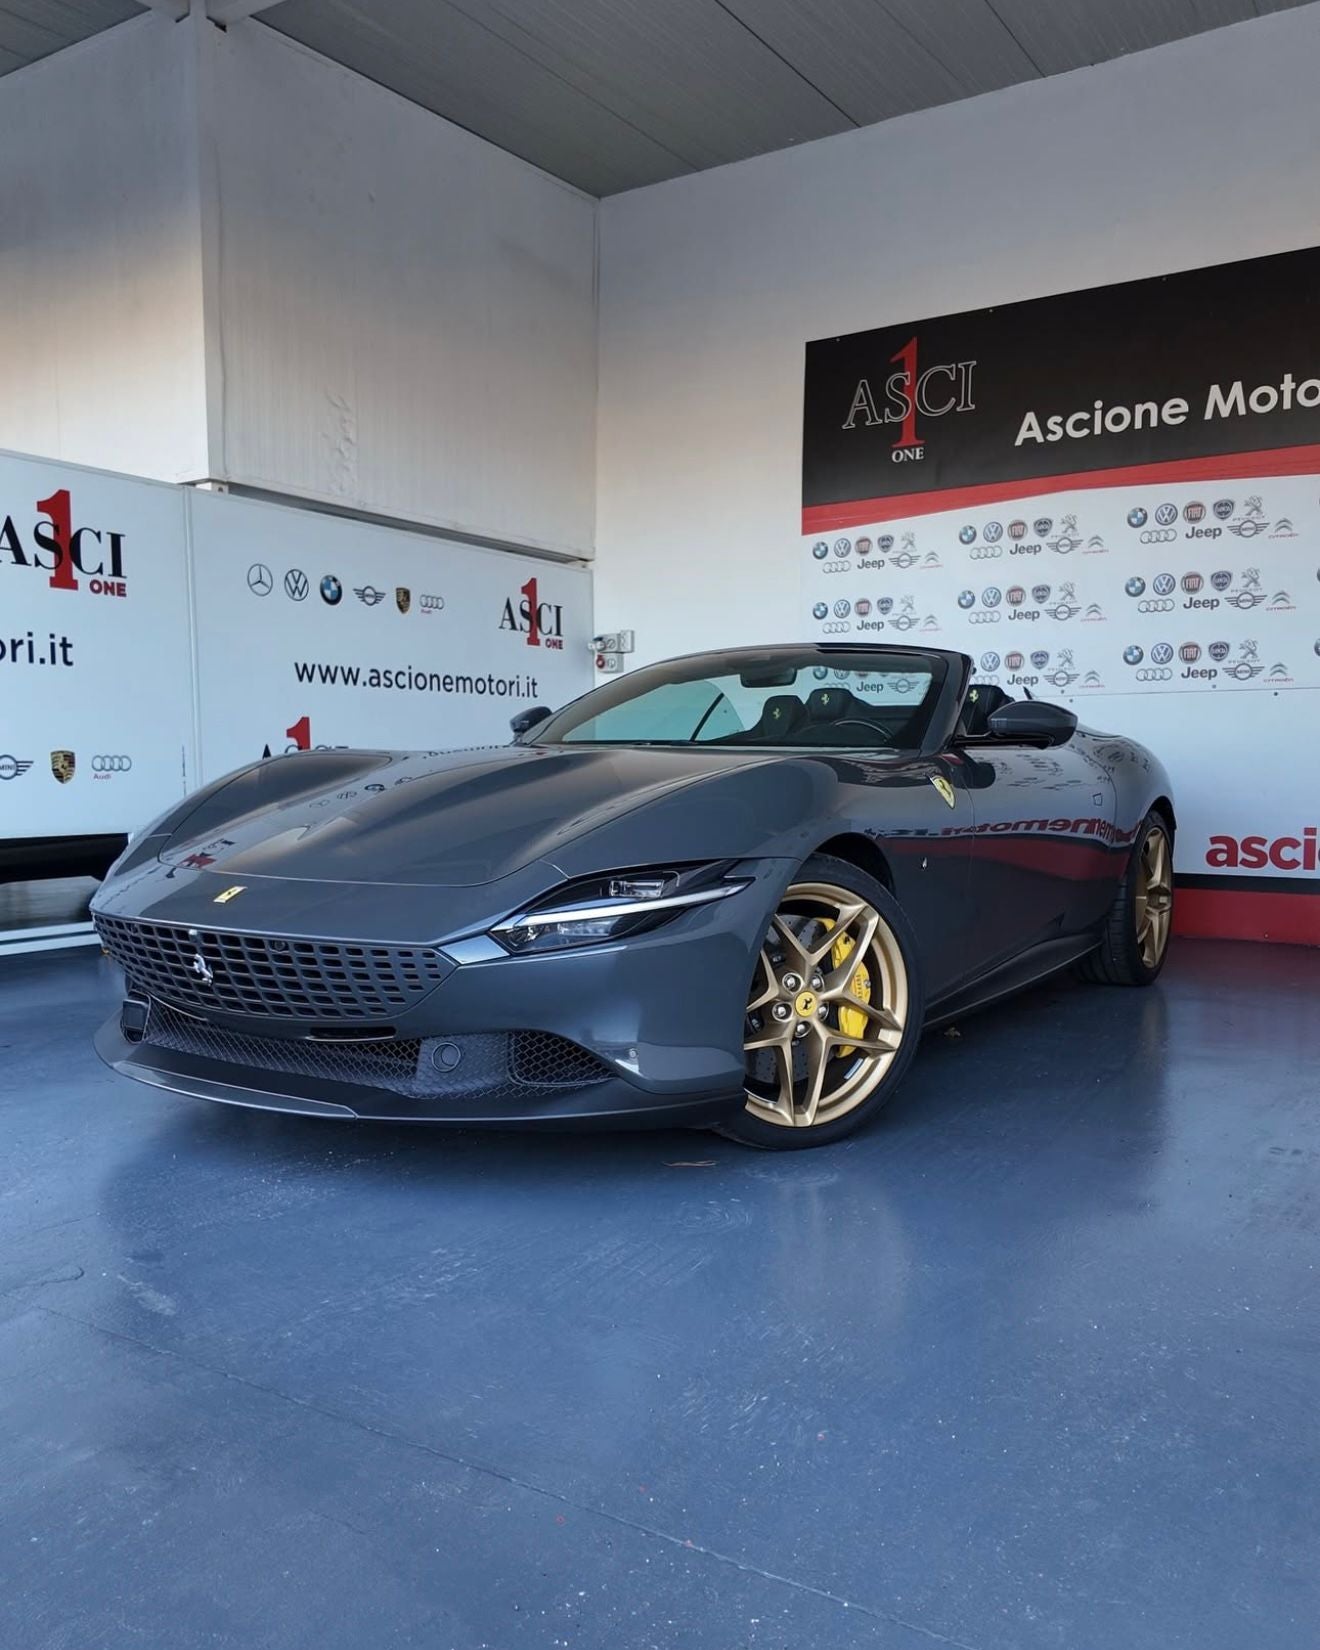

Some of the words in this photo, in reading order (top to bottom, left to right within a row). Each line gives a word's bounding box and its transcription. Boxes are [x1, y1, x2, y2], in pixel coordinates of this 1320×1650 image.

[1014, 398, 1189, 446] Ascione
[1204, 373, 1320, 420] Moto
[892, 447, 924, 463] ONE
[1185, 526, 1222, 540] Jeep
[1009, 543, 1042, 556] Jeep
[857, 558, 885, 571] Jeep
[89, 579, 127, 597] ONE
[1183, 597, 1220, 611] Jeep
[1008, 608, 1041, 622] Jeep
[856, 620, 885, 632] Jeep
[545, 638, 563, 650] ONE
[294, 662, 538, 698] www.ascionemotori.it
[1181, 666, 1218, 681] Jeep
[856, 682, 884, 694] Jeep
[1006, 674, 1039, 688] Jeep
[1206, 827, 1320, 870] asci
